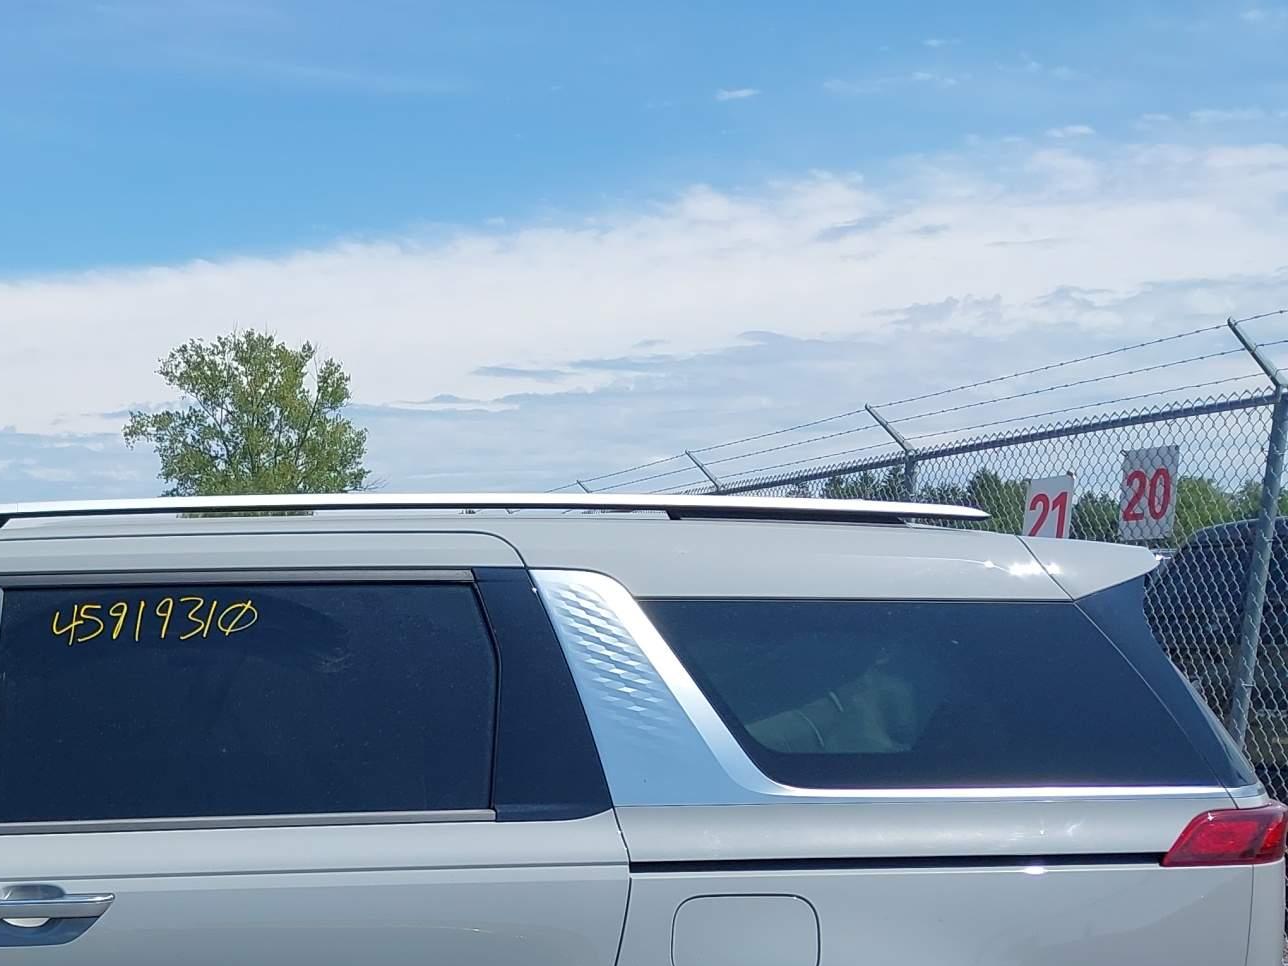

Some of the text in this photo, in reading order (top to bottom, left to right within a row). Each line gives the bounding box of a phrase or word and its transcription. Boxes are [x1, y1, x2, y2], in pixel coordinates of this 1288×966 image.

[1029, 490, 1069, 539] 21
[1122, 466, 1172, 522] 20
[52, 597, 258, 646] 45919310
